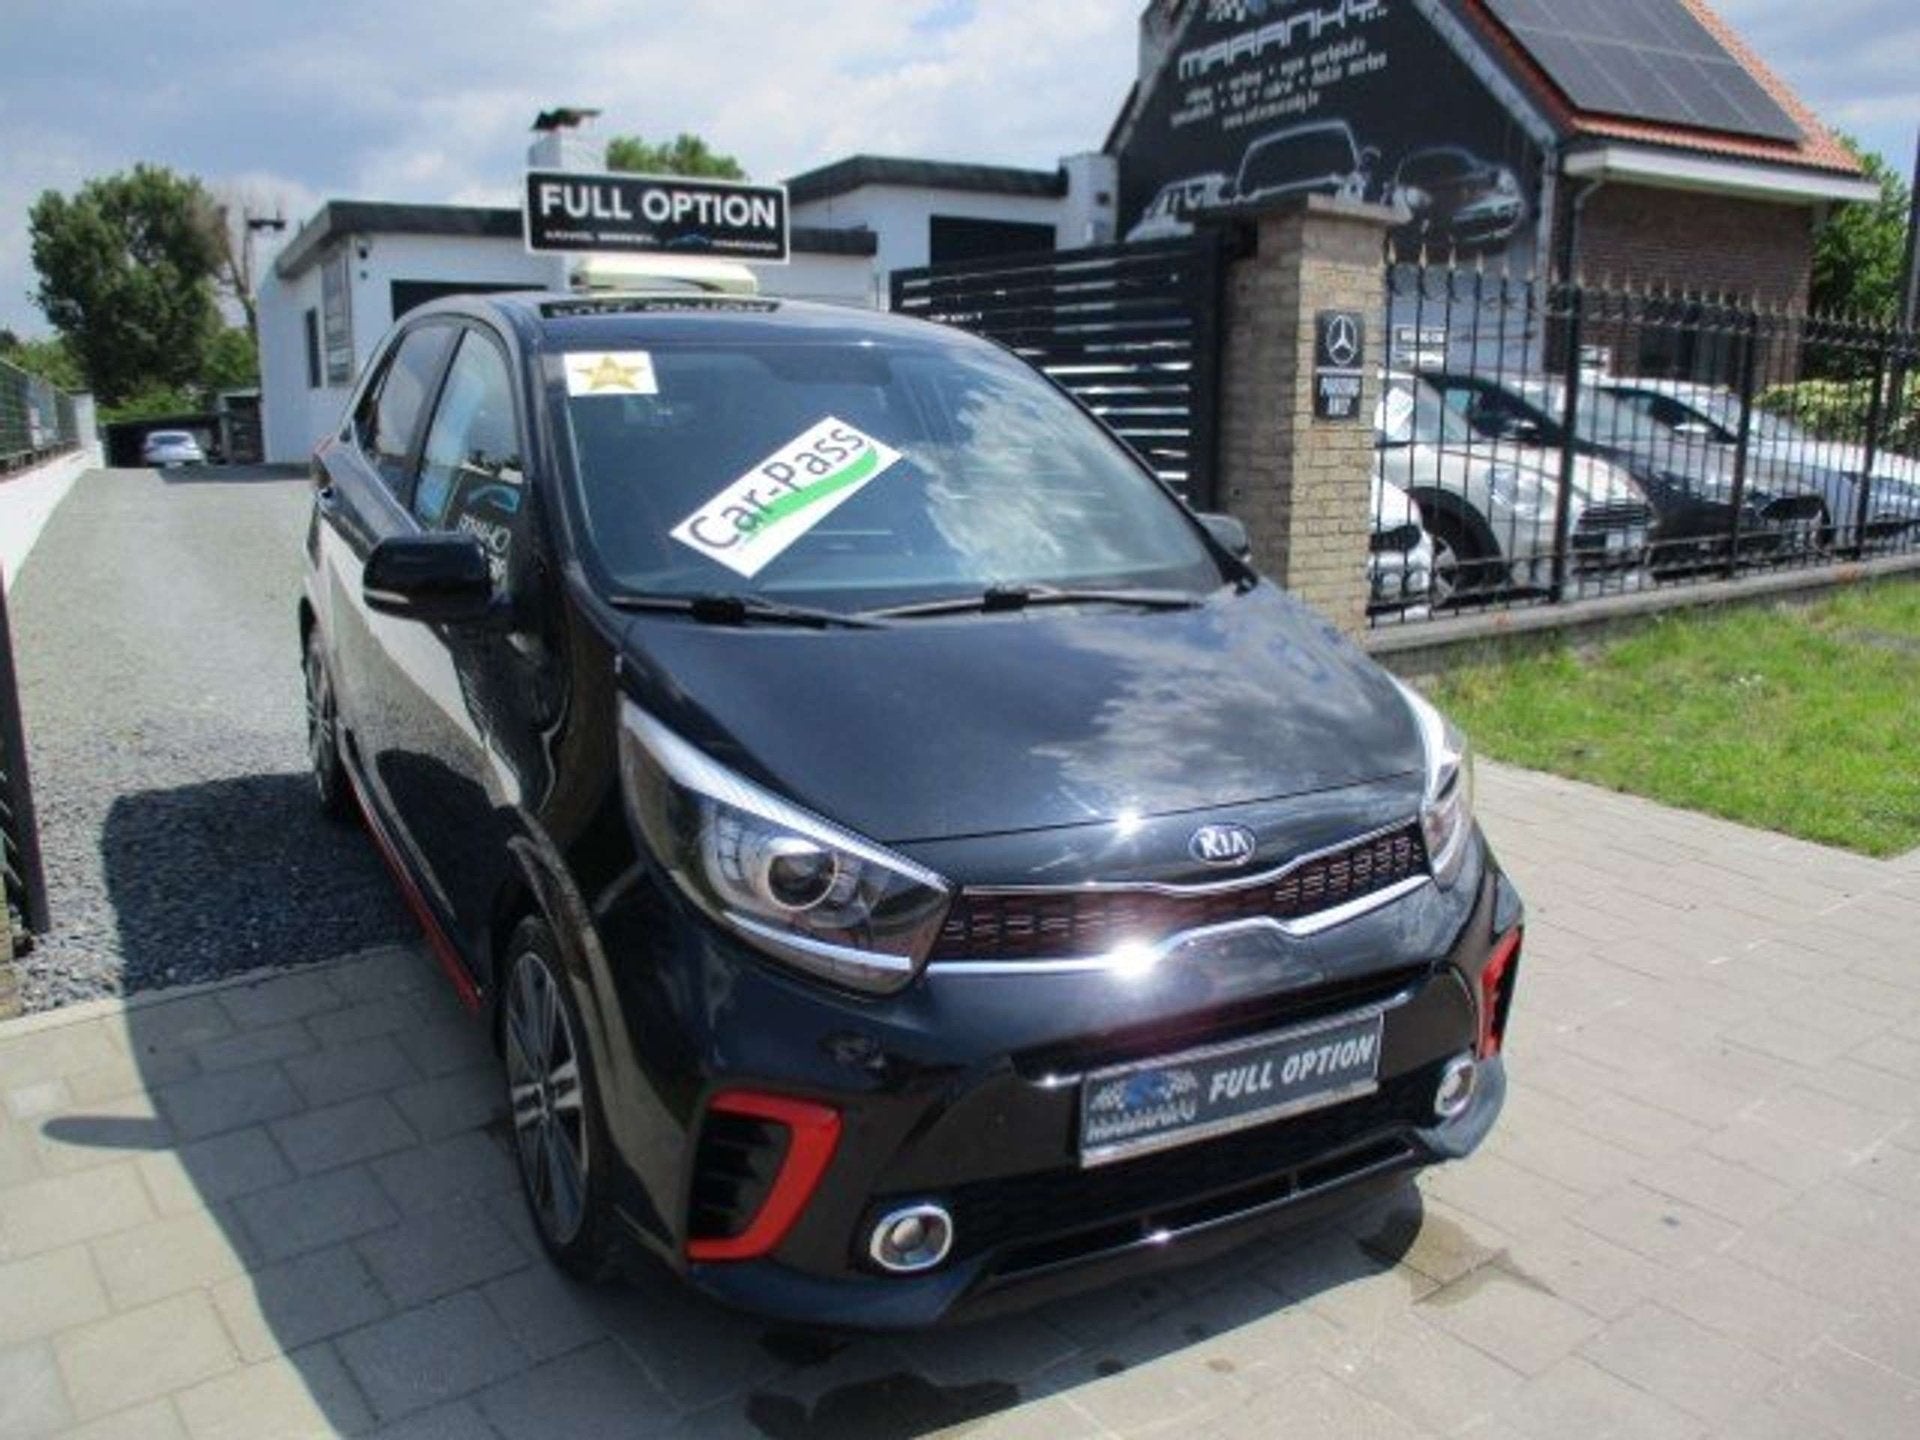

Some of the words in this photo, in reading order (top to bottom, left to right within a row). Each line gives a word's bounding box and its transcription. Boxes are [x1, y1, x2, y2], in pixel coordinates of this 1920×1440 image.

[540, 183, 632, 220] FULL
[641, 189, 776, 228] OPTION
[688, 427, 864, 549] Car-Pass
[1200, 829, 1250, 859] KIA
[1209, 1064, 1272, 1102] FULL
[1282, 1034, 1376, 1084] OPTION
